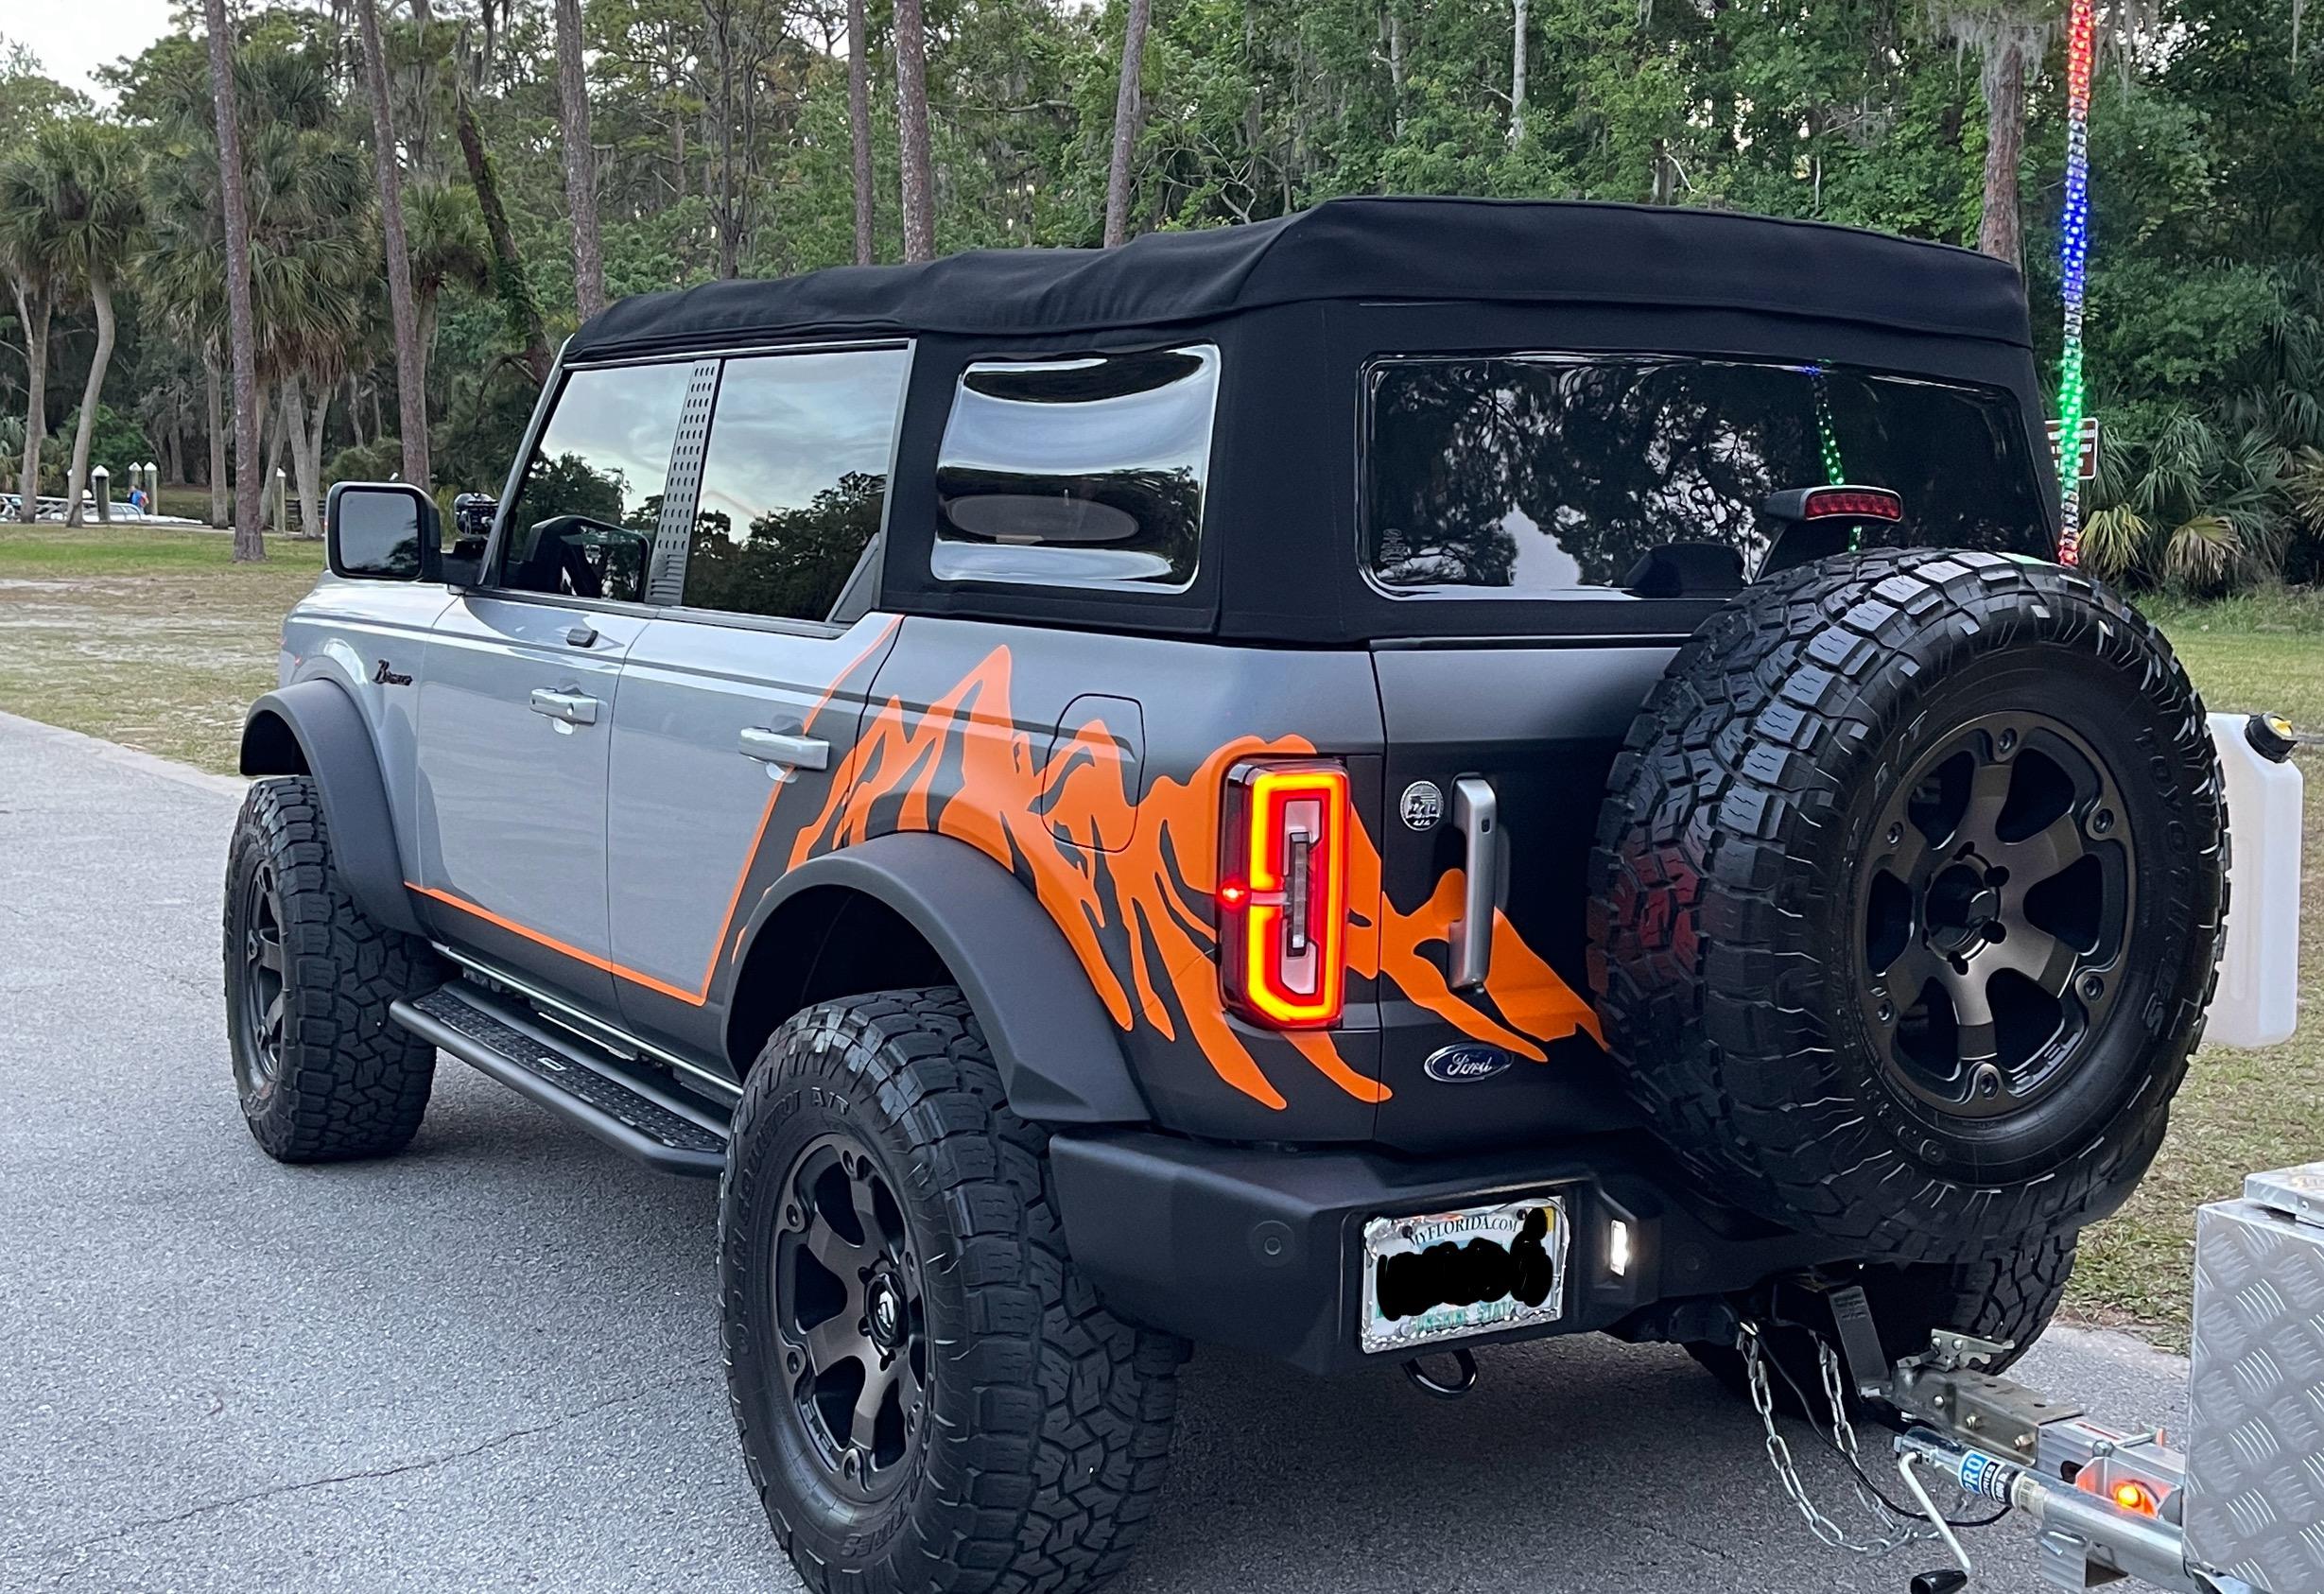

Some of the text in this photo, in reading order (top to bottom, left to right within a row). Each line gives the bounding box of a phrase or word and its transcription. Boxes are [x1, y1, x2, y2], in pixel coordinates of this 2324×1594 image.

[1447, 1052, 1493, 1076] Ford
[810, 1086, 851, 1117] A/T
[1409, 1215, 1518, 1246] MYFLORIDA.COM
